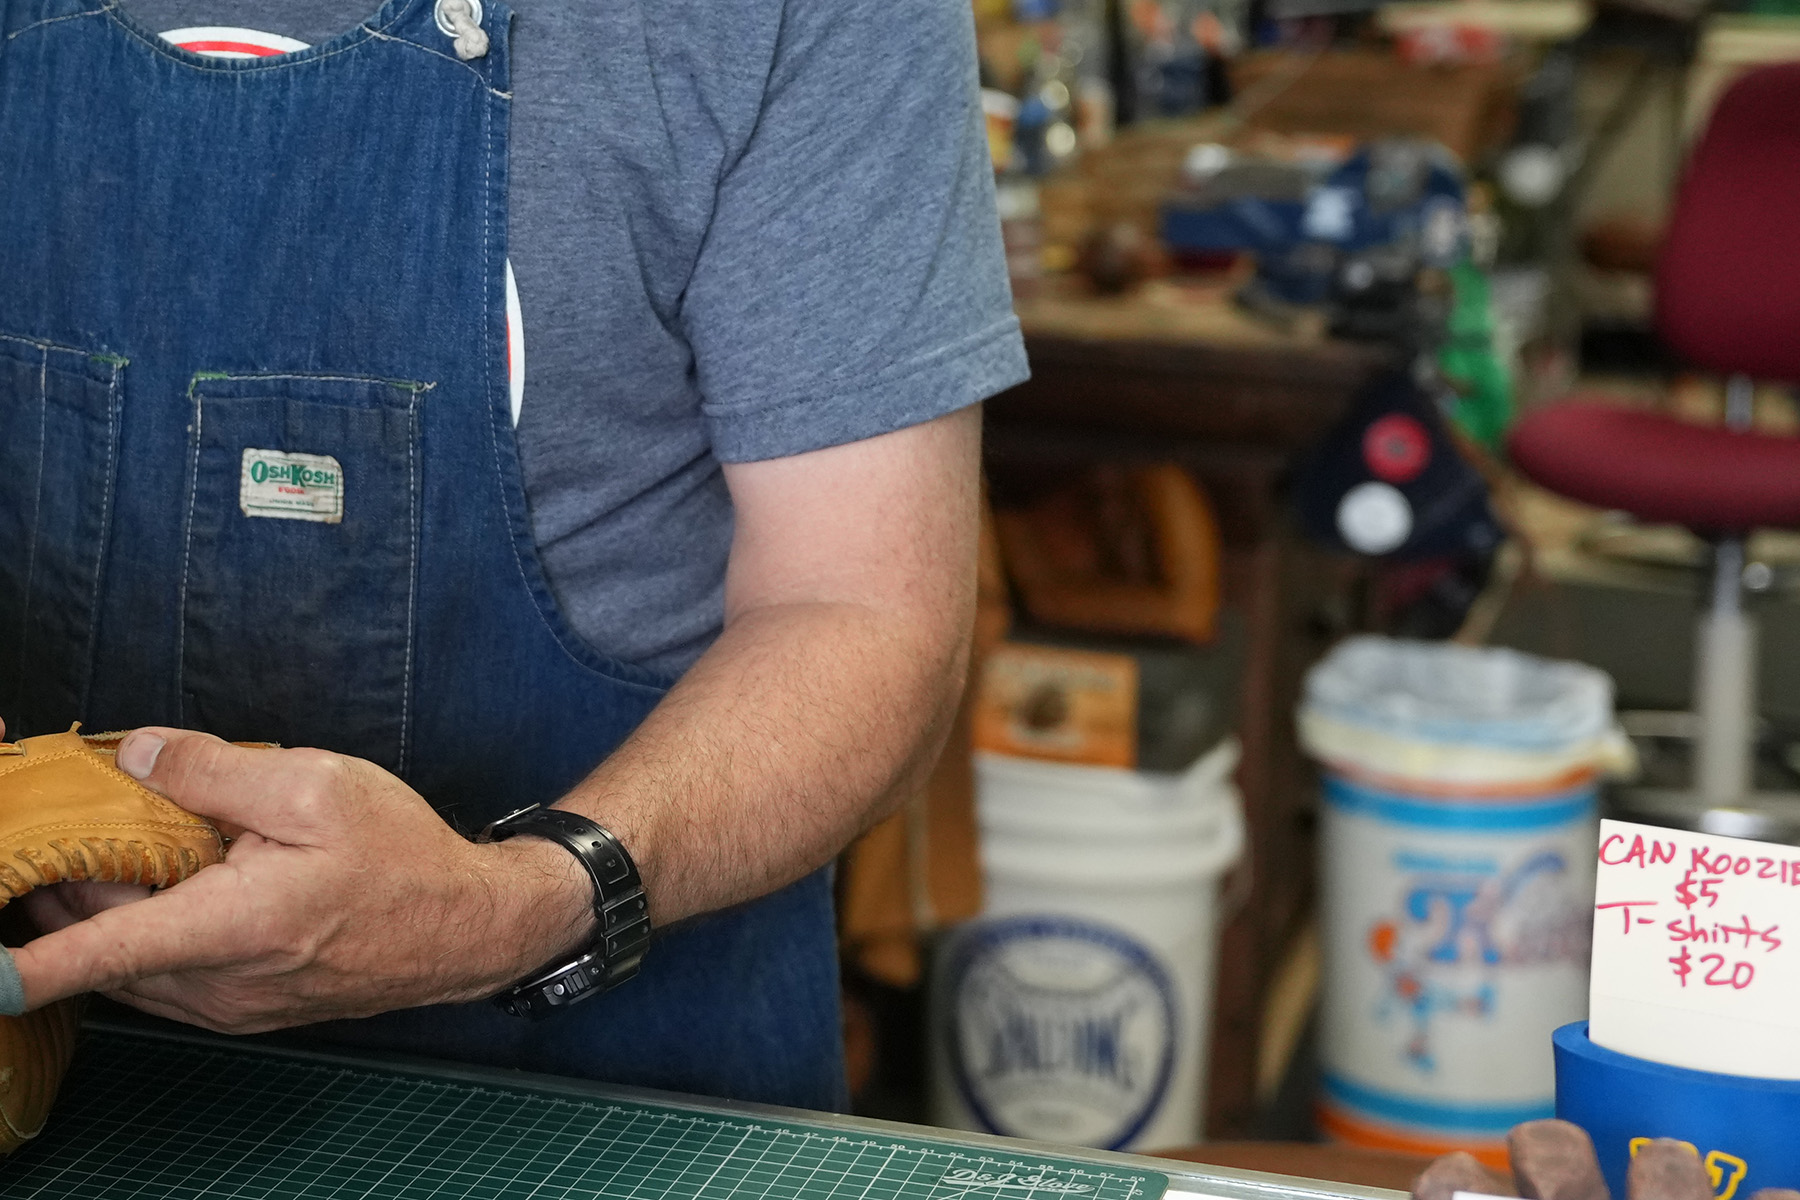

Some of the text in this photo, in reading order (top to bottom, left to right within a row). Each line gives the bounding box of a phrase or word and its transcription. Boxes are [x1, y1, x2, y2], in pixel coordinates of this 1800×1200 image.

[1599, 834, 1677, 868] CAN
[1675, 870, 1725, 910] $5
[1668, 946, 1755, 990] $20
